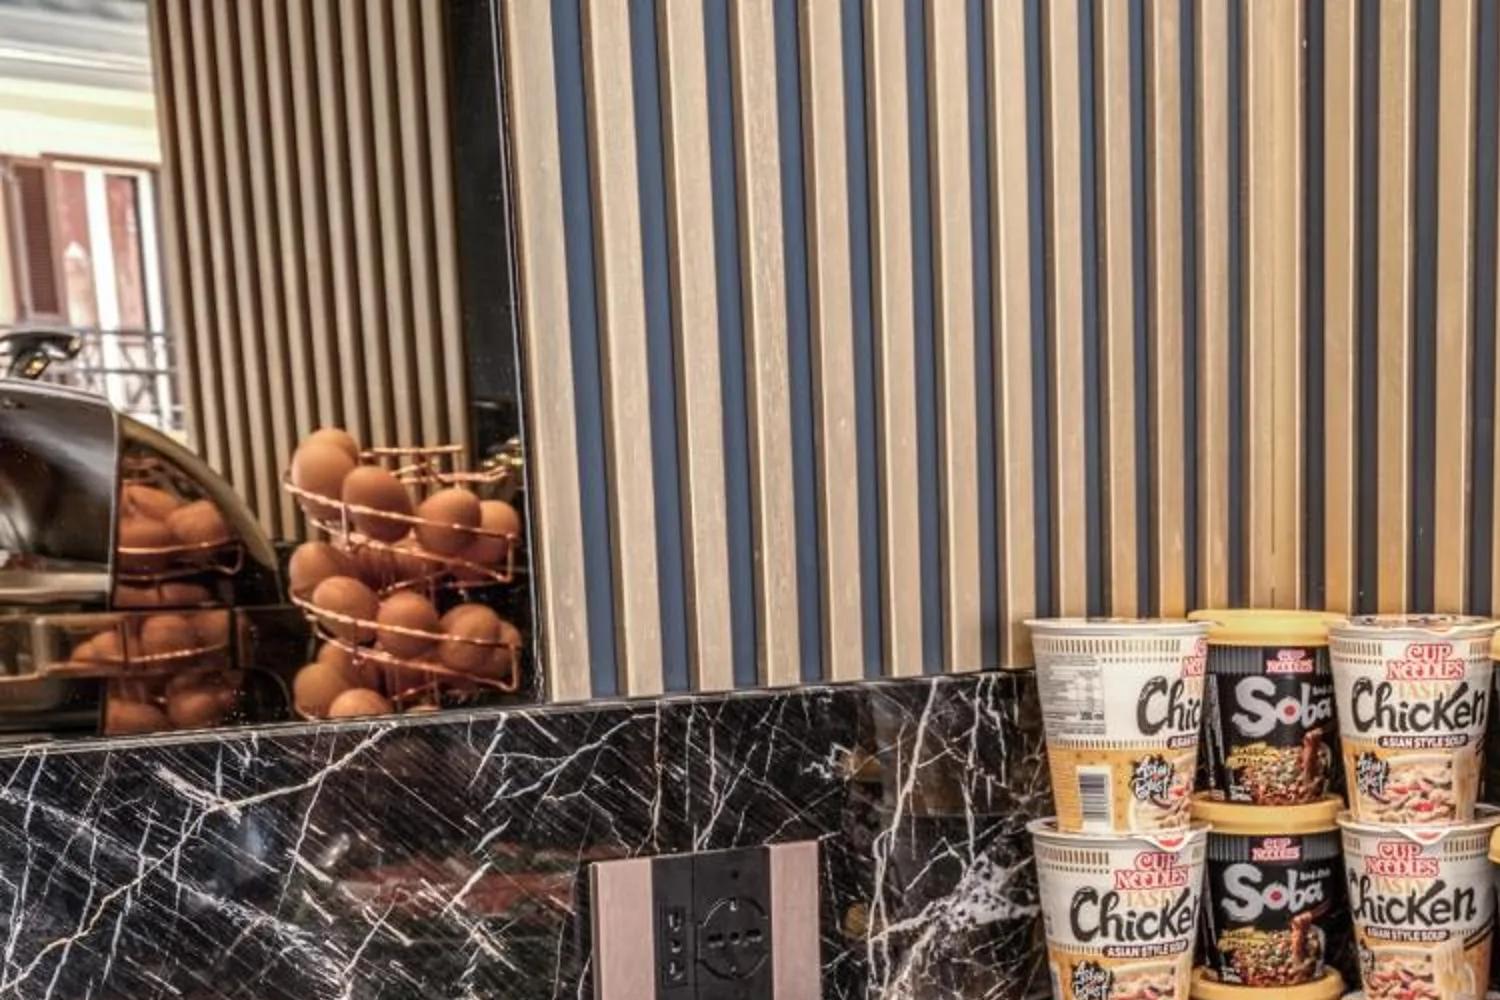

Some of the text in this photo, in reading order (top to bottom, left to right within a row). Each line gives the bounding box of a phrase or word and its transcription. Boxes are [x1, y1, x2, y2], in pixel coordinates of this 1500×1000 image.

[1406, 643, 1453, 662] CUP
[1386, 658, 1465, 680] NOODLES
[1231, 675, 1332, 739] Soba
[1351, 676, 1487, 733] Chicken
[1135, 851, 1180, 871] CUP
[1378, 841, 1424, 860] CUP
[1364, 855, 1440, 877] NOODLES
[1114, 865, 1190, 890] NOODLES
[1221, 862, 1325, 922] Soba
